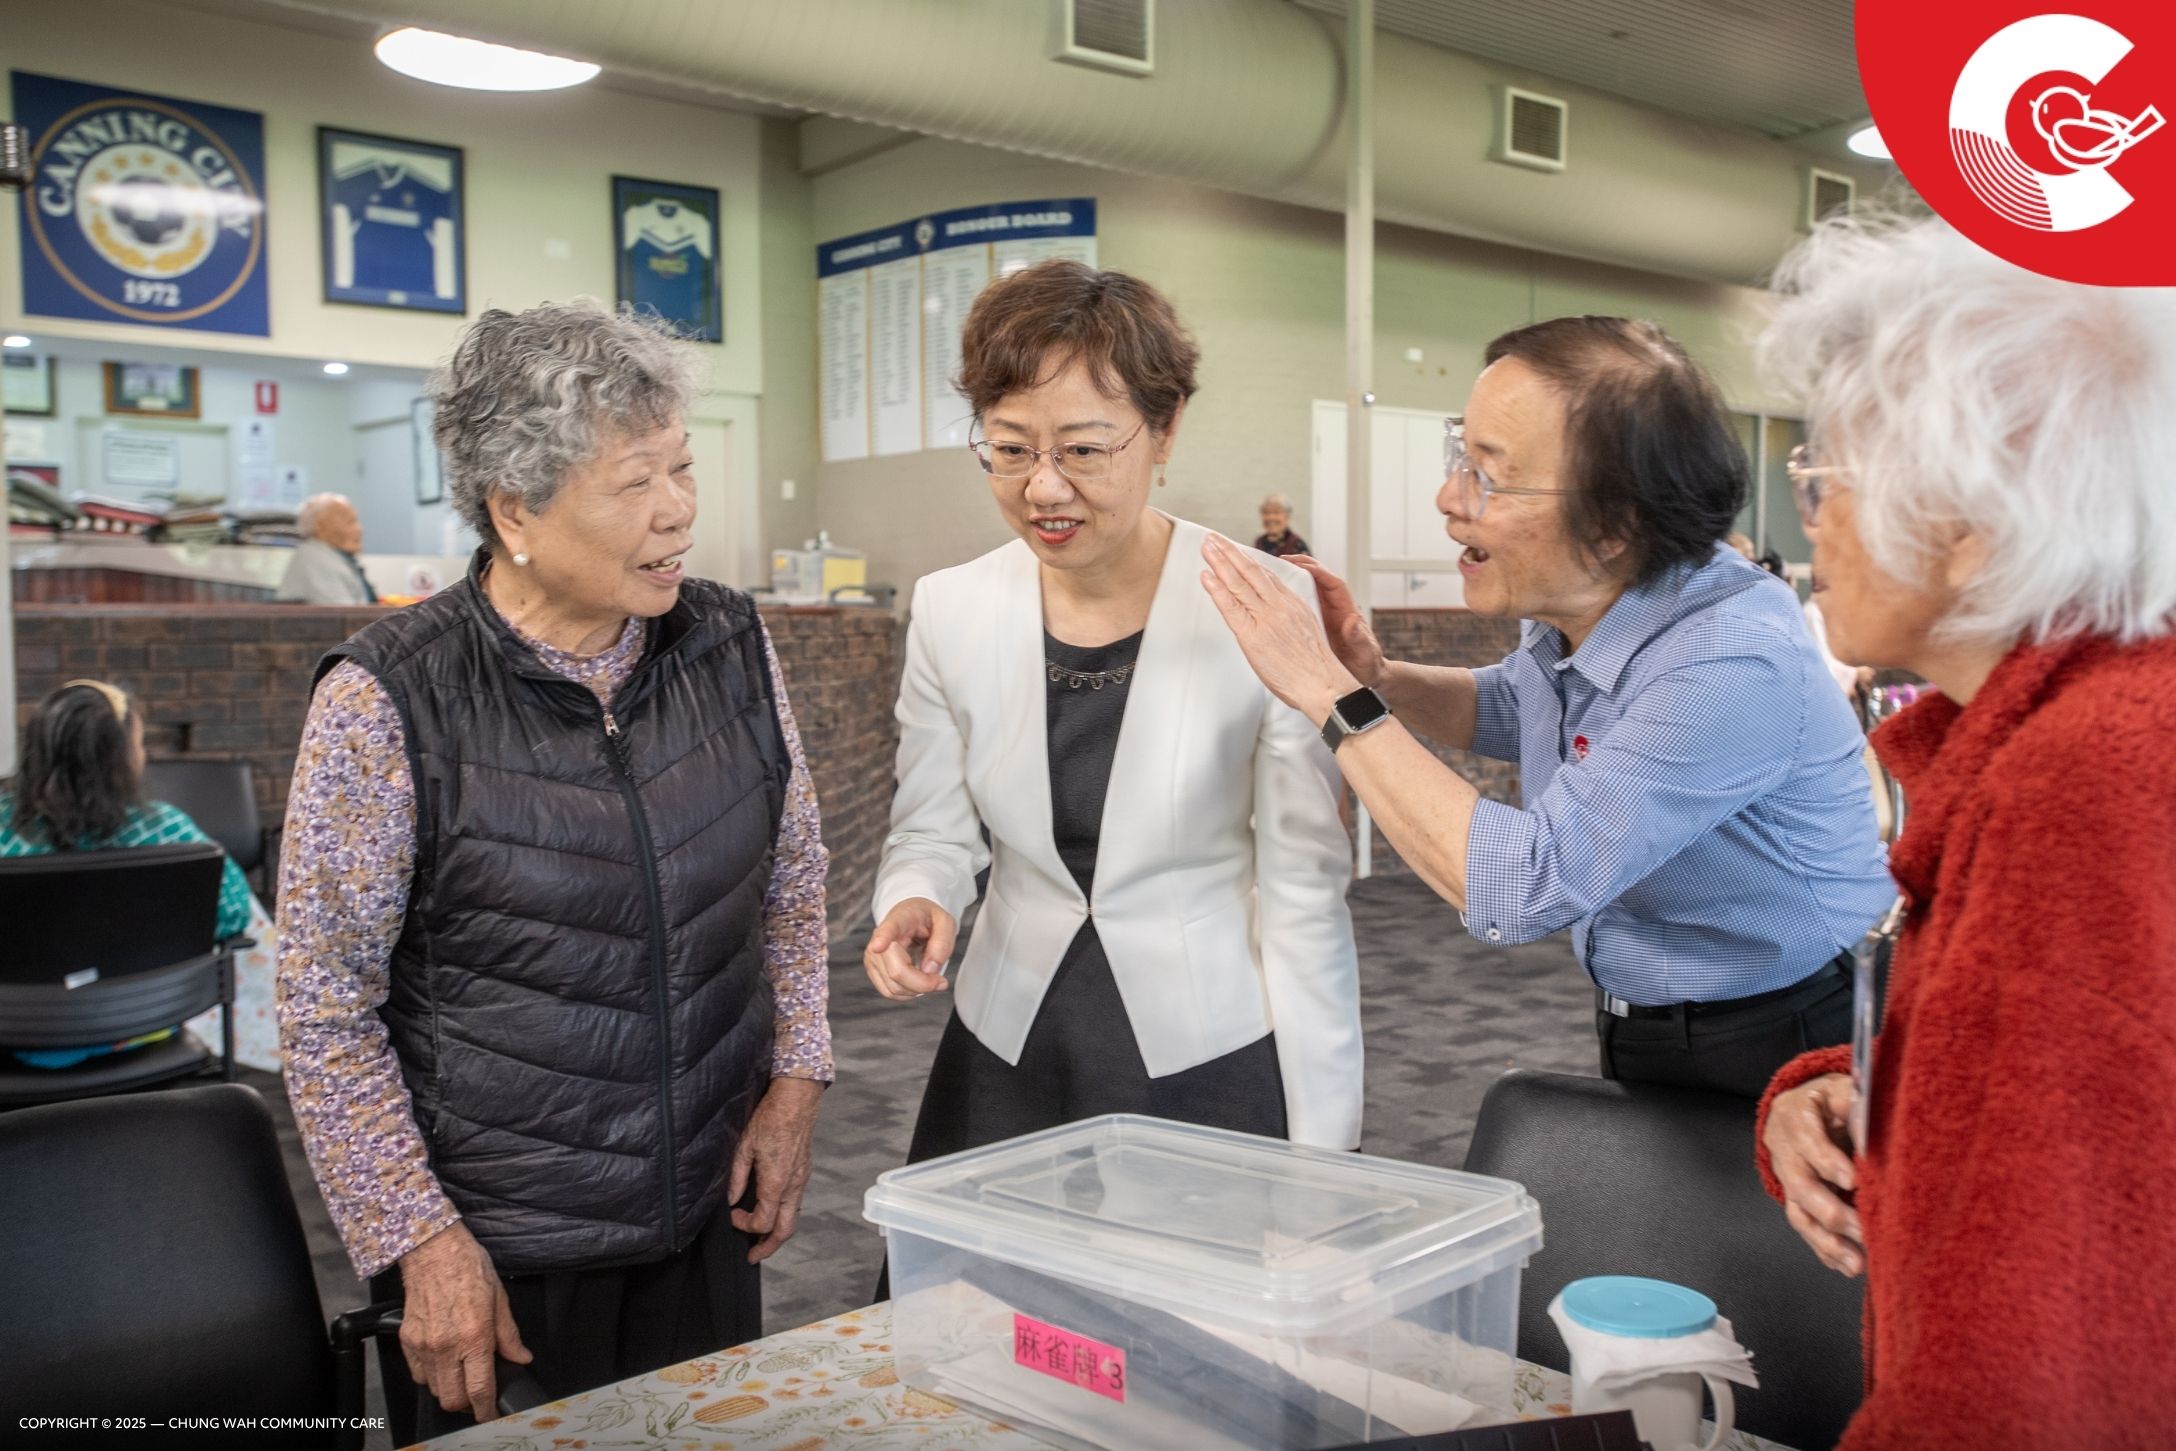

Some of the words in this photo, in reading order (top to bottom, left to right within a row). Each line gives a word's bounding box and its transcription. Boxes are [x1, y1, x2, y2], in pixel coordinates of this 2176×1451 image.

[39, 111, 190, 217] CANNING
[122, 280, 182, 307] 1972
[1016, 1324, 1100, 1384] 麻雀牌
